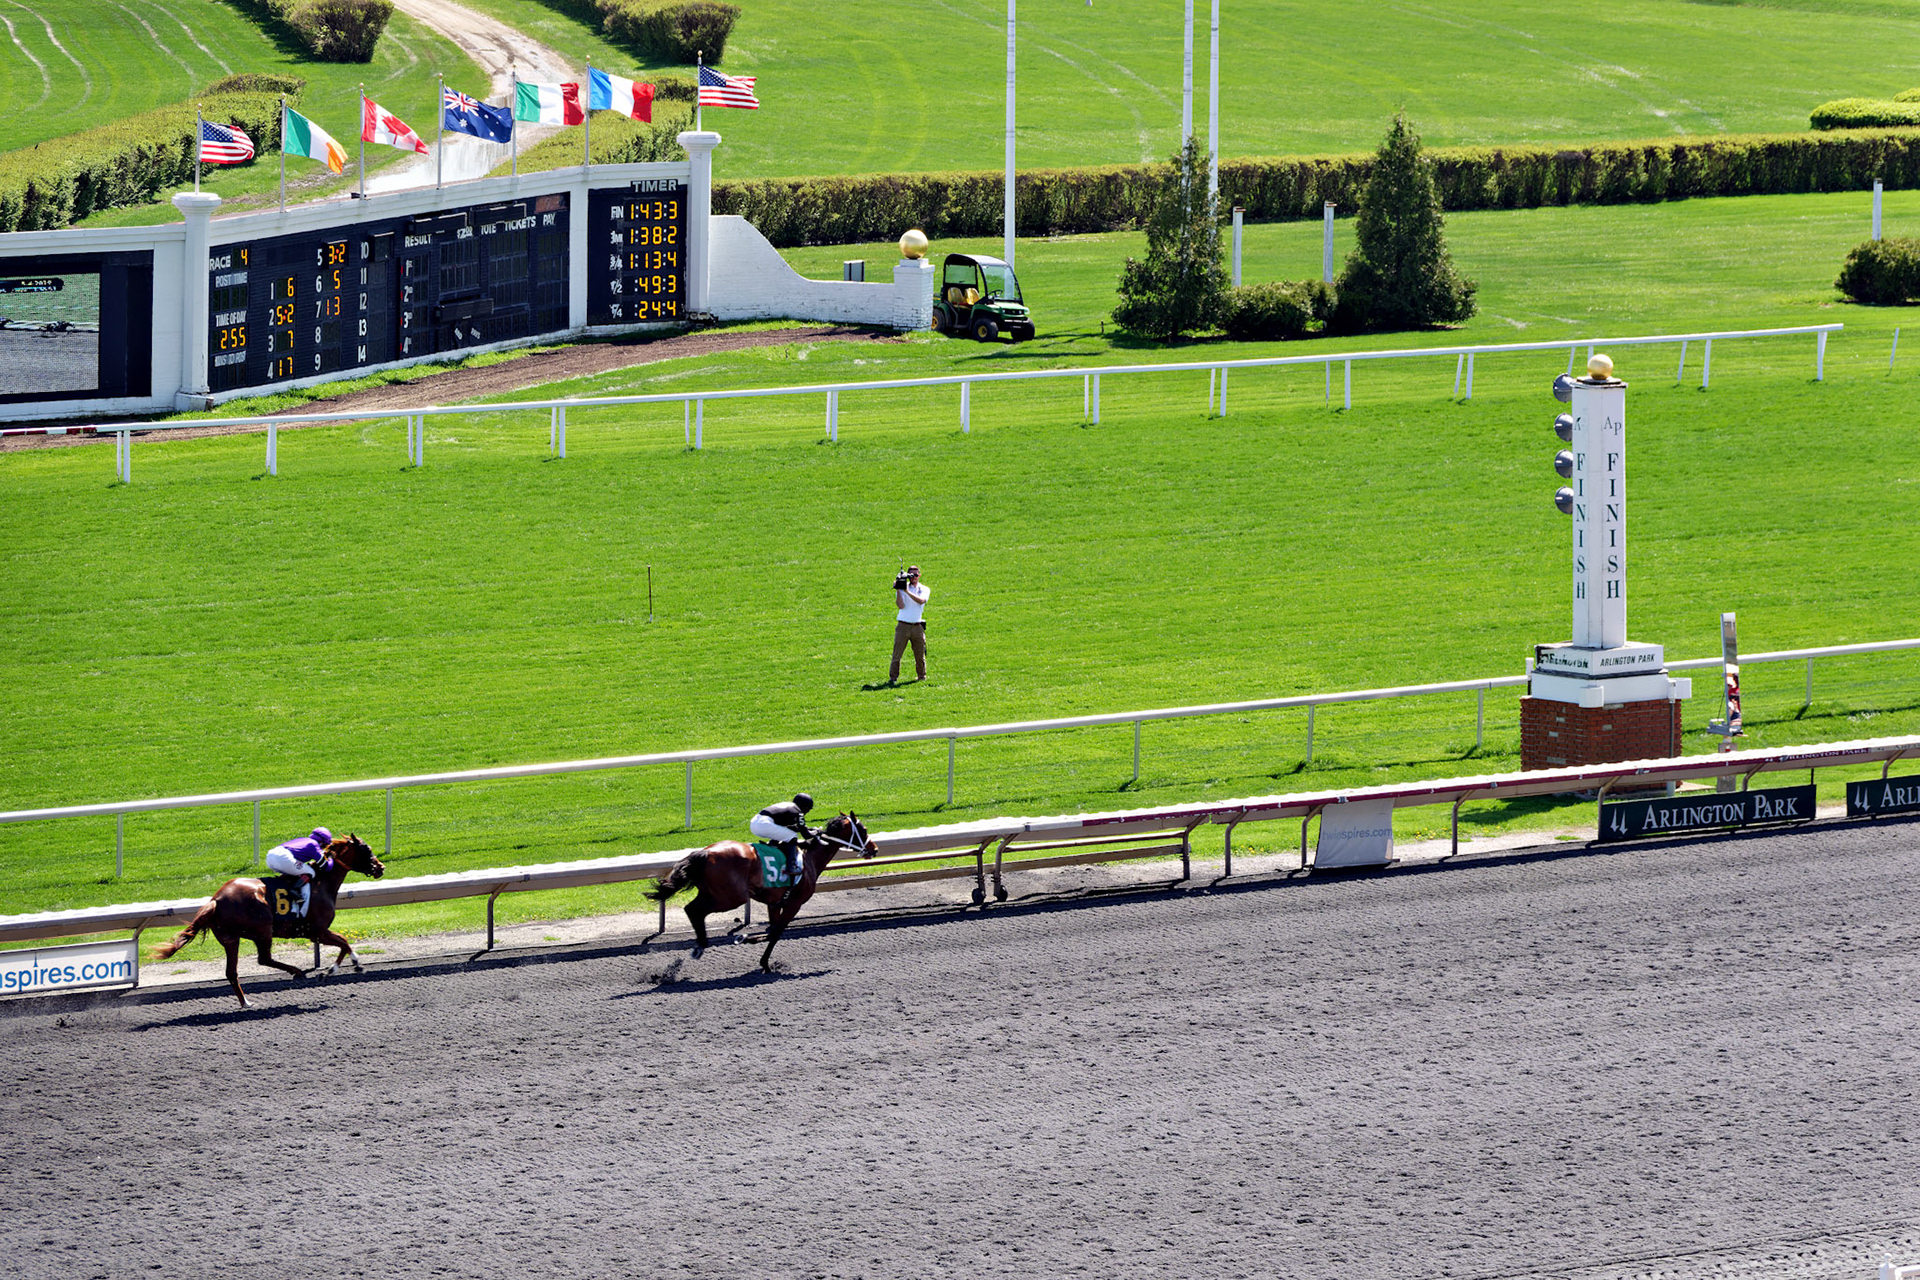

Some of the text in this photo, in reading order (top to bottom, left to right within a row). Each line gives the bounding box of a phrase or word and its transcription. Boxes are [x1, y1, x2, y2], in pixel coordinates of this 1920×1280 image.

[632, 179, 677, 193] TIMER
[611, 206, 624, 219] FIN
[504, 215, 536, 232] TICKETS
[542, 213, 556, 226] PAY
[404, 233, 432, 248] RESULT
[317, 248, 323, 266] 5
[360, 241, 369, 259] 10
[209, 248, 248, 271] RACE 4
[215, 274, 232, 288] POST
[315, 270, 341, 293] 6 5
[360, 267, 367, 285] 11
[270, 277, 294, 300] 1 6
[316, 300, 322, 318] 7
[360, 292, 367, 310] 12
[215, 310, 247, 327] TIME OF DAY
[268, 308, 275, 326] 2
[315, 326, 322, 343] 8
[358, 318, 367, 336] 13
[267, 330, 294, 352] 3 7
[314, 353, 321, 371] 9
[357, 344, 366, 363] 14
[267, 361, 274, 379] 4
[1576, 453, 1586, 600] FINISH
[1606, 453, 1620, 600] FINISH
[1599, 653, 1656, 667] ARLINGTON PARK
[1642, 794, 1799, 831] ARLINGTON PARK
[1322, 827, 1392, 840] twinspires.com
[274, 888, 290, 915] 6
[0, 953, 131, 991] spires.com
